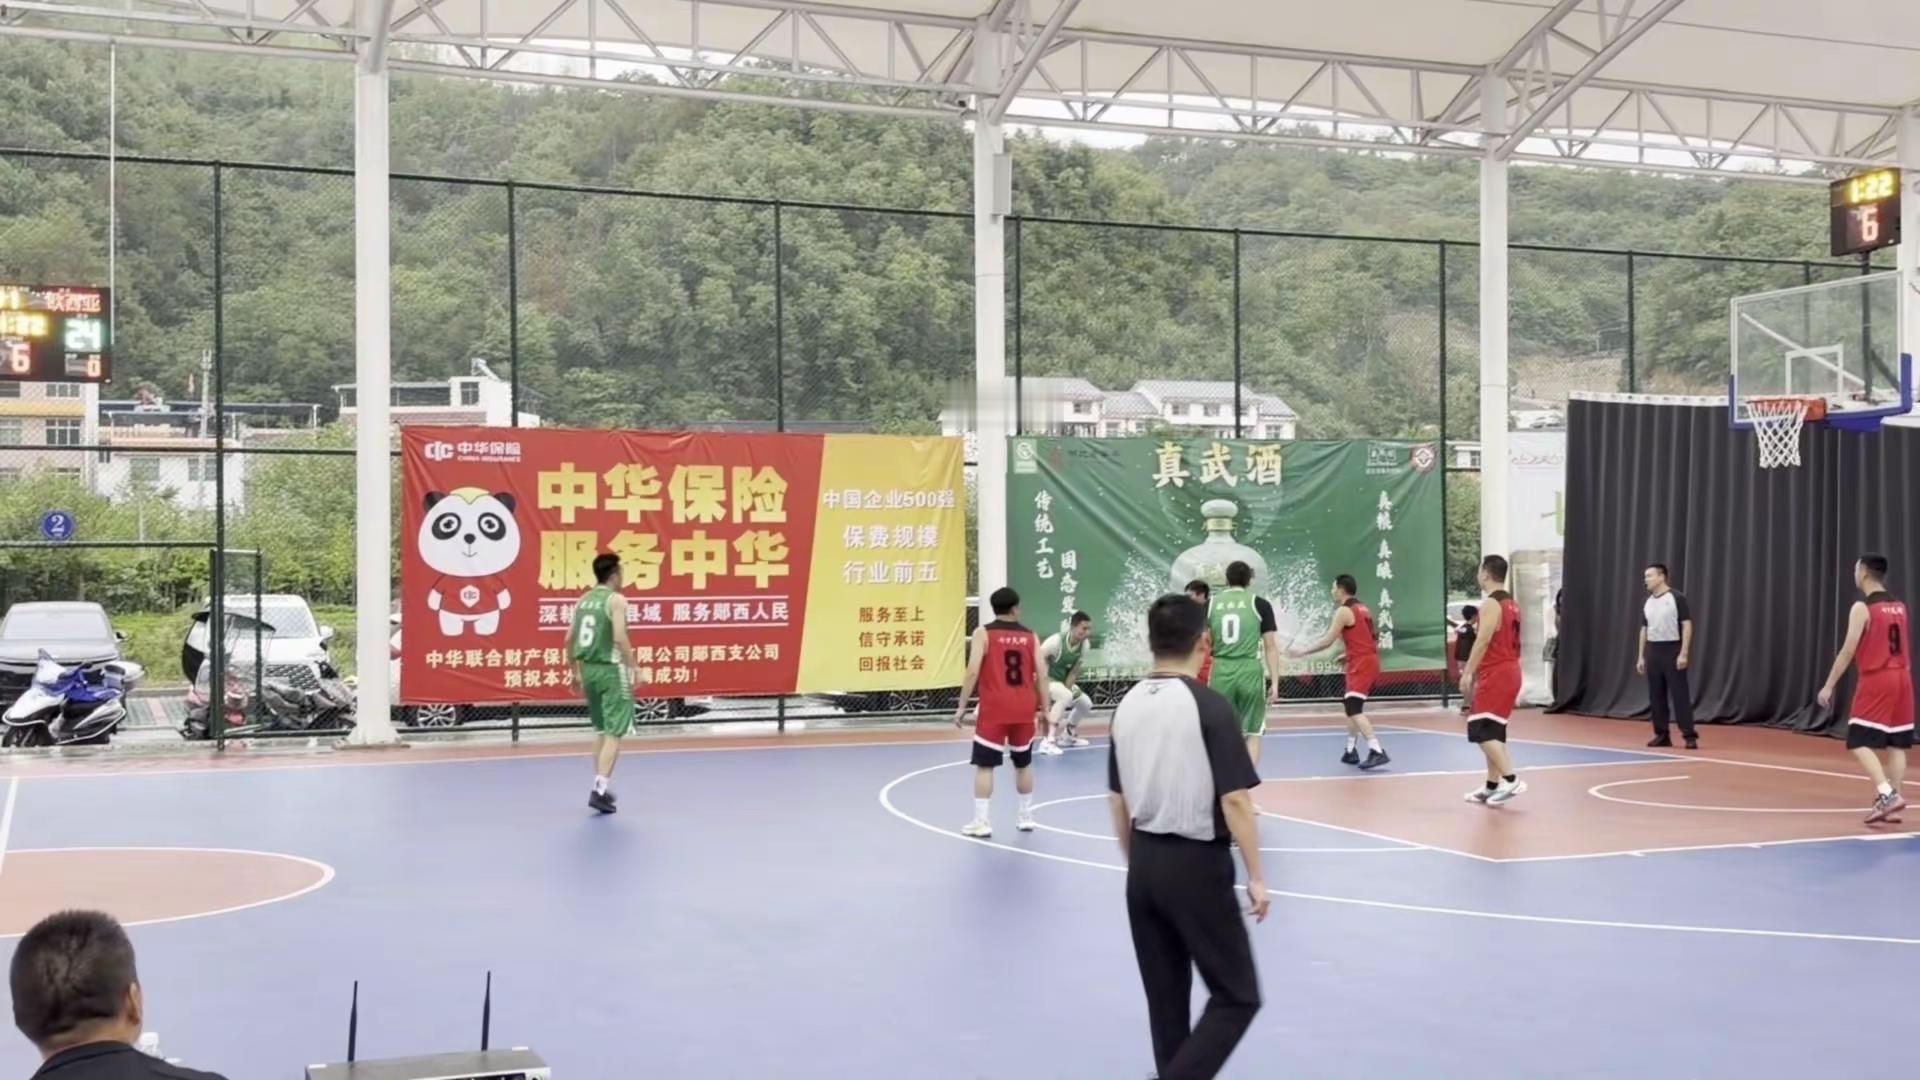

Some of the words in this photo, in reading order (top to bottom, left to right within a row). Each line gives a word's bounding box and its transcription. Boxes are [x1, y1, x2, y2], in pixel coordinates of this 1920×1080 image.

[1850, 171, 1894, 203] 1:22
[1861, 206, 1879, 241] 6
[65, 318, 102, 349] 24
[12, 342, 31, 373] 6
[457, 441, 521, 455] 中华保险
[1152, 440, 1283, 488] 真武酒
[538, 462, 789, 524] 中华保险
[823, 488, 956, 509] 中国企业500强
[51, 514, 65, 533] 2
[843, 524, 939, 549] 保费规模
[1034, 490, 1054, 579] 传统工艺
[538, 529, 790, 590] 服务中华
[843, 560, 939, 585] 行业前五
[538, 603, 662, 624] 深耕县域
[672, 601, 790, 622] 服务郧西人民
[858, 606, 926, 624] 服务至上
[578, 614, 597, 649] 6
[858, 630, 926, 648] 信守承诺
[1222, 613, 1241, 645] 0
[858, 654, 926, 673] 回报社会
[1004, 649, 1024, 688] 8
